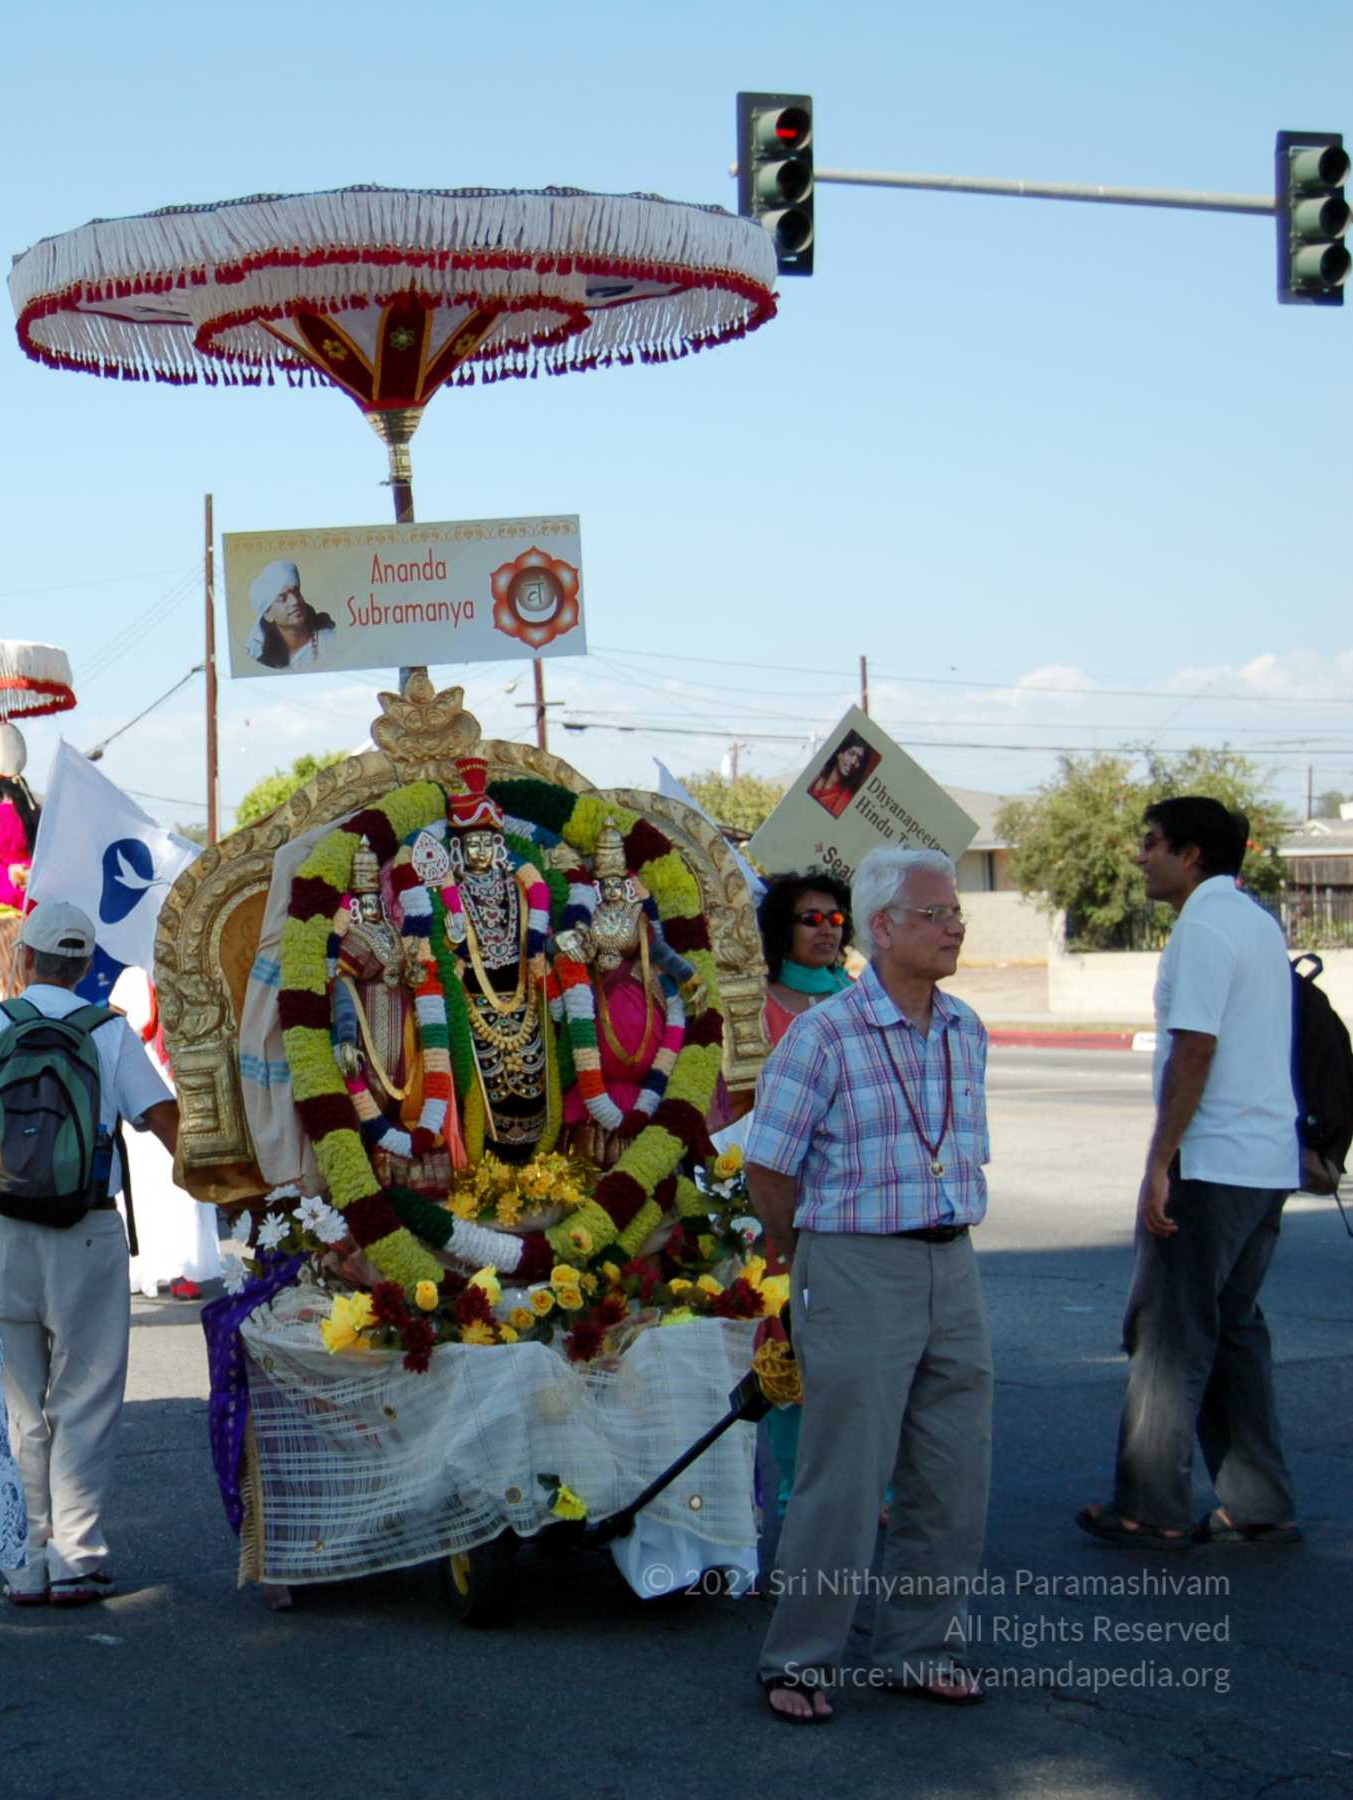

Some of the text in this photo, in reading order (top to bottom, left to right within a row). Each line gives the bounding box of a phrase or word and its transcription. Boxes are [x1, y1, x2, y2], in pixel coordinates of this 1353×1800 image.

[370, 548, 446, 585] Ananda
[346, 593, 474, 629] Subramanya
[854, 796, 895, 839] Hindu
